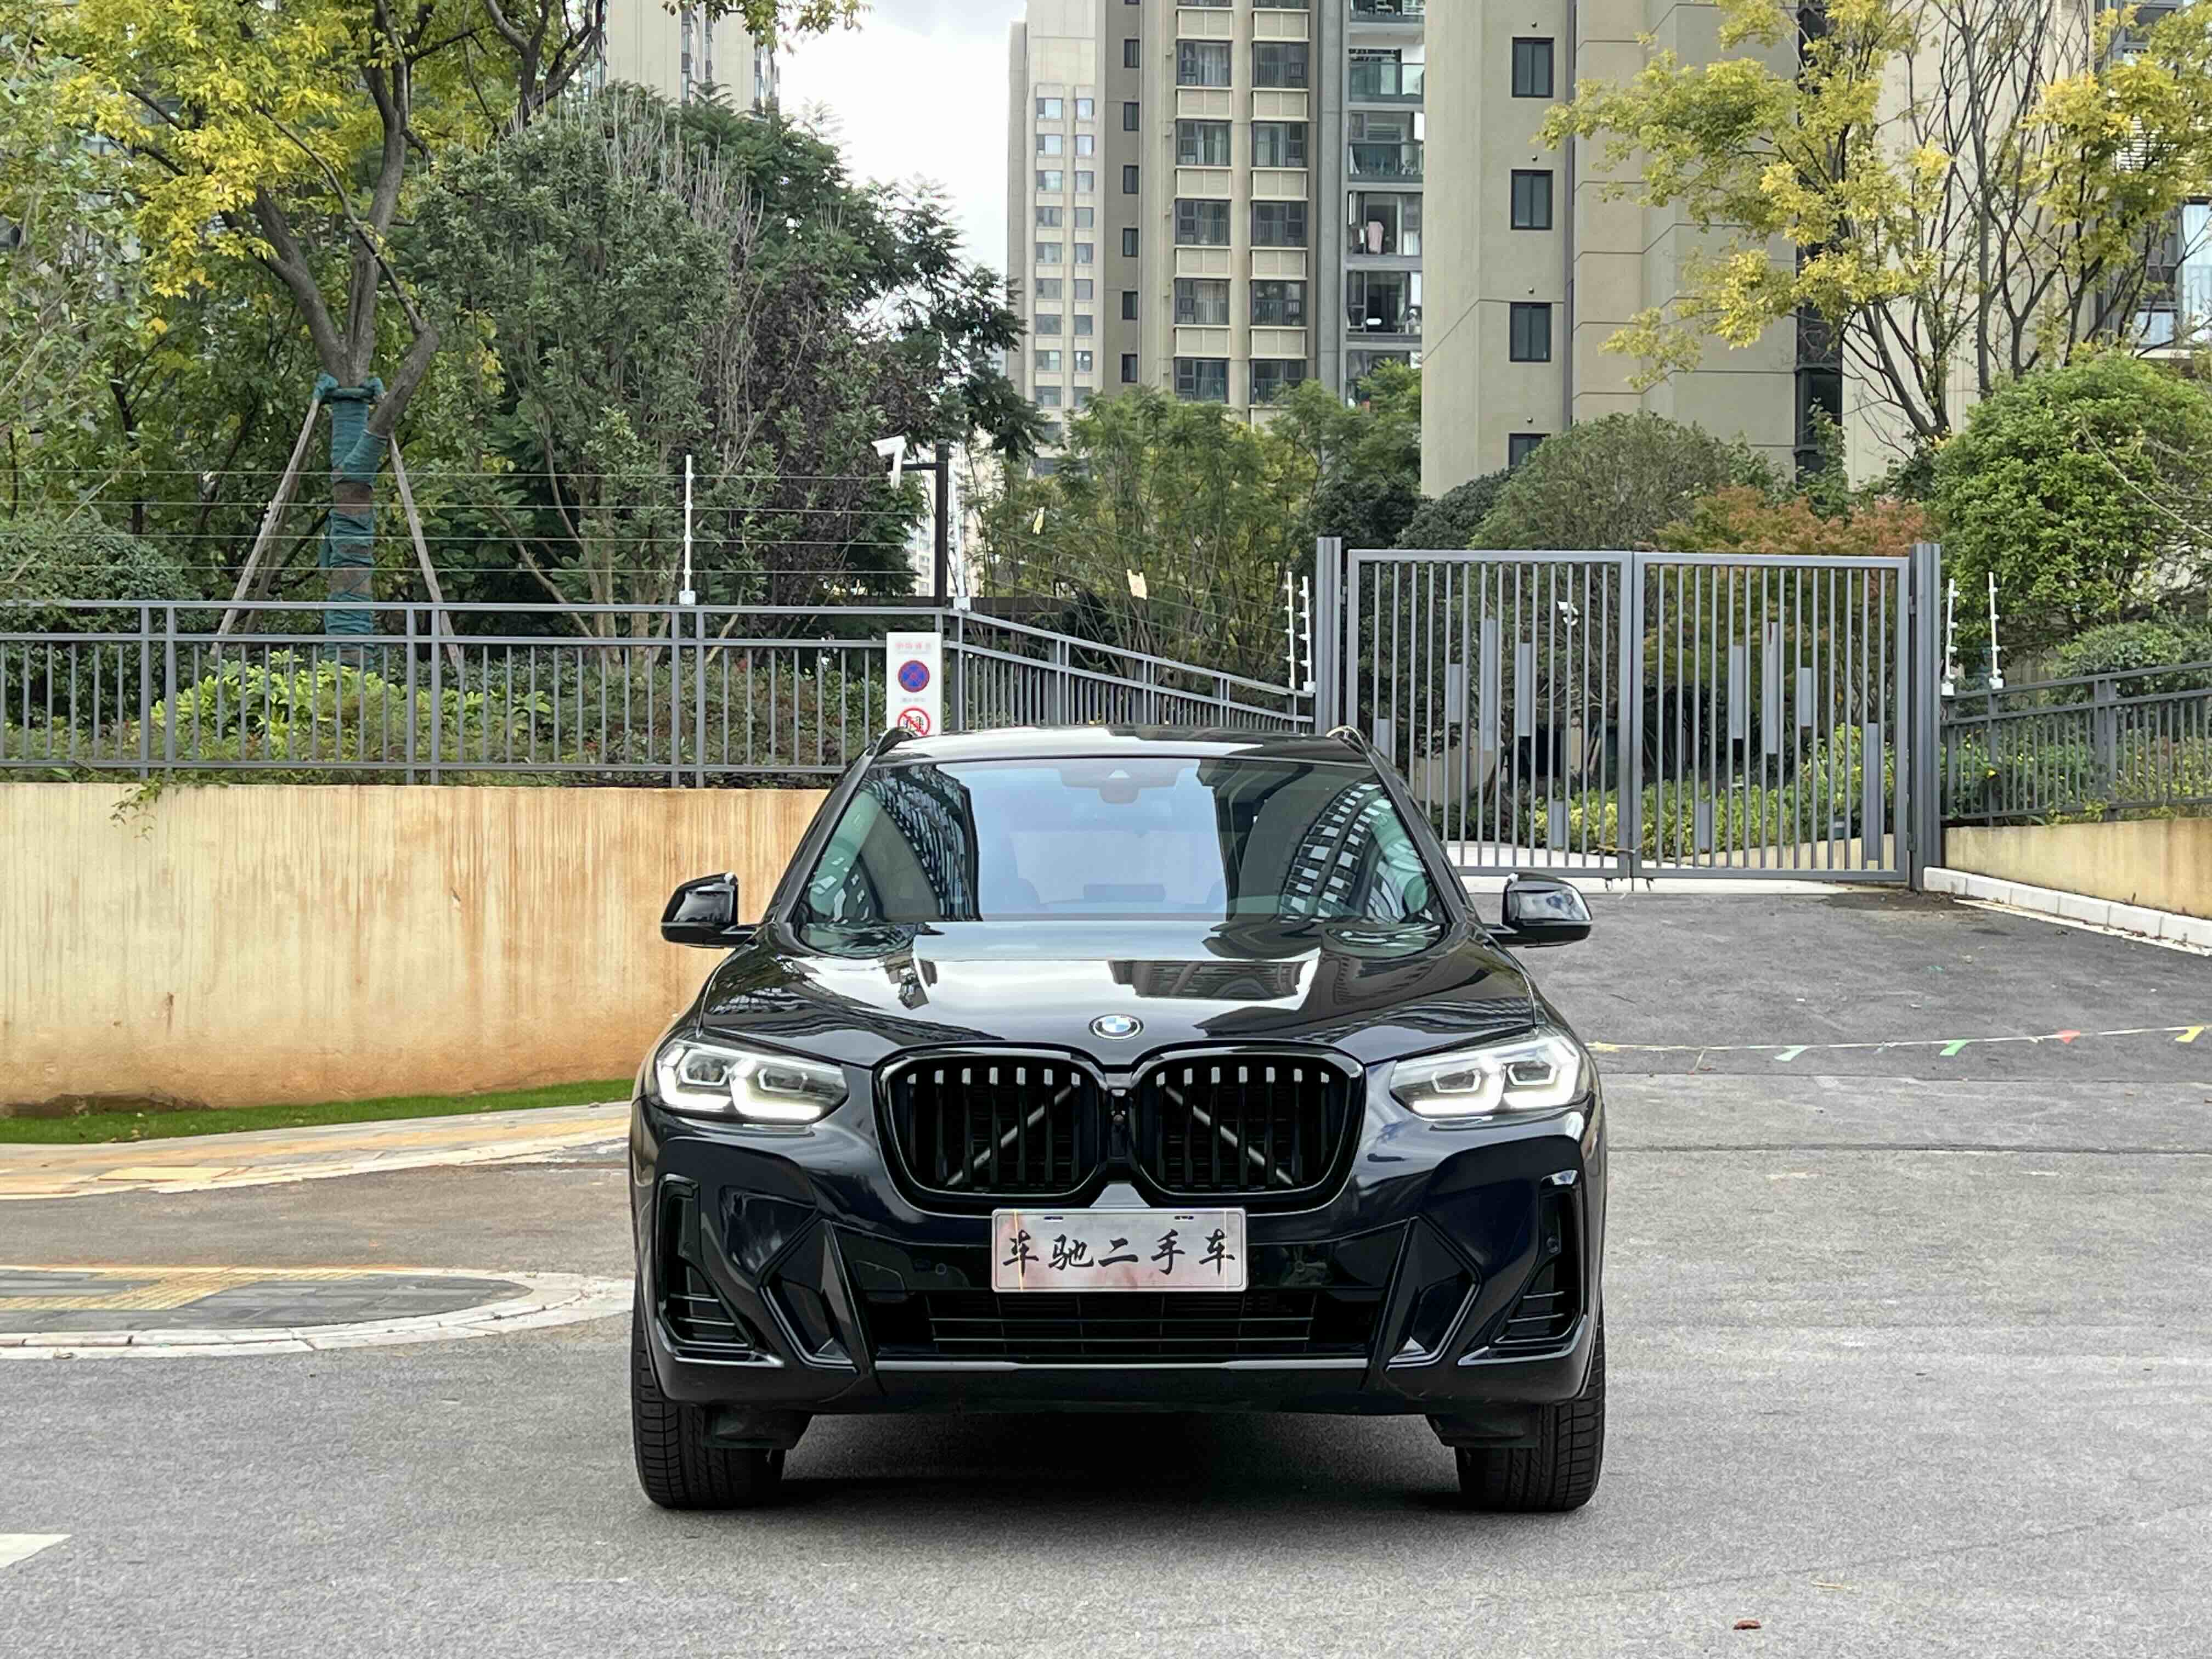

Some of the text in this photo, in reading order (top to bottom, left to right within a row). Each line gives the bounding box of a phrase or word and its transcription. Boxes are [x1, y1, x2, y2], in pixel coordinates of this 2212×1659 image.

[1003, 1229, 1235, 1277] 车驰二手车
